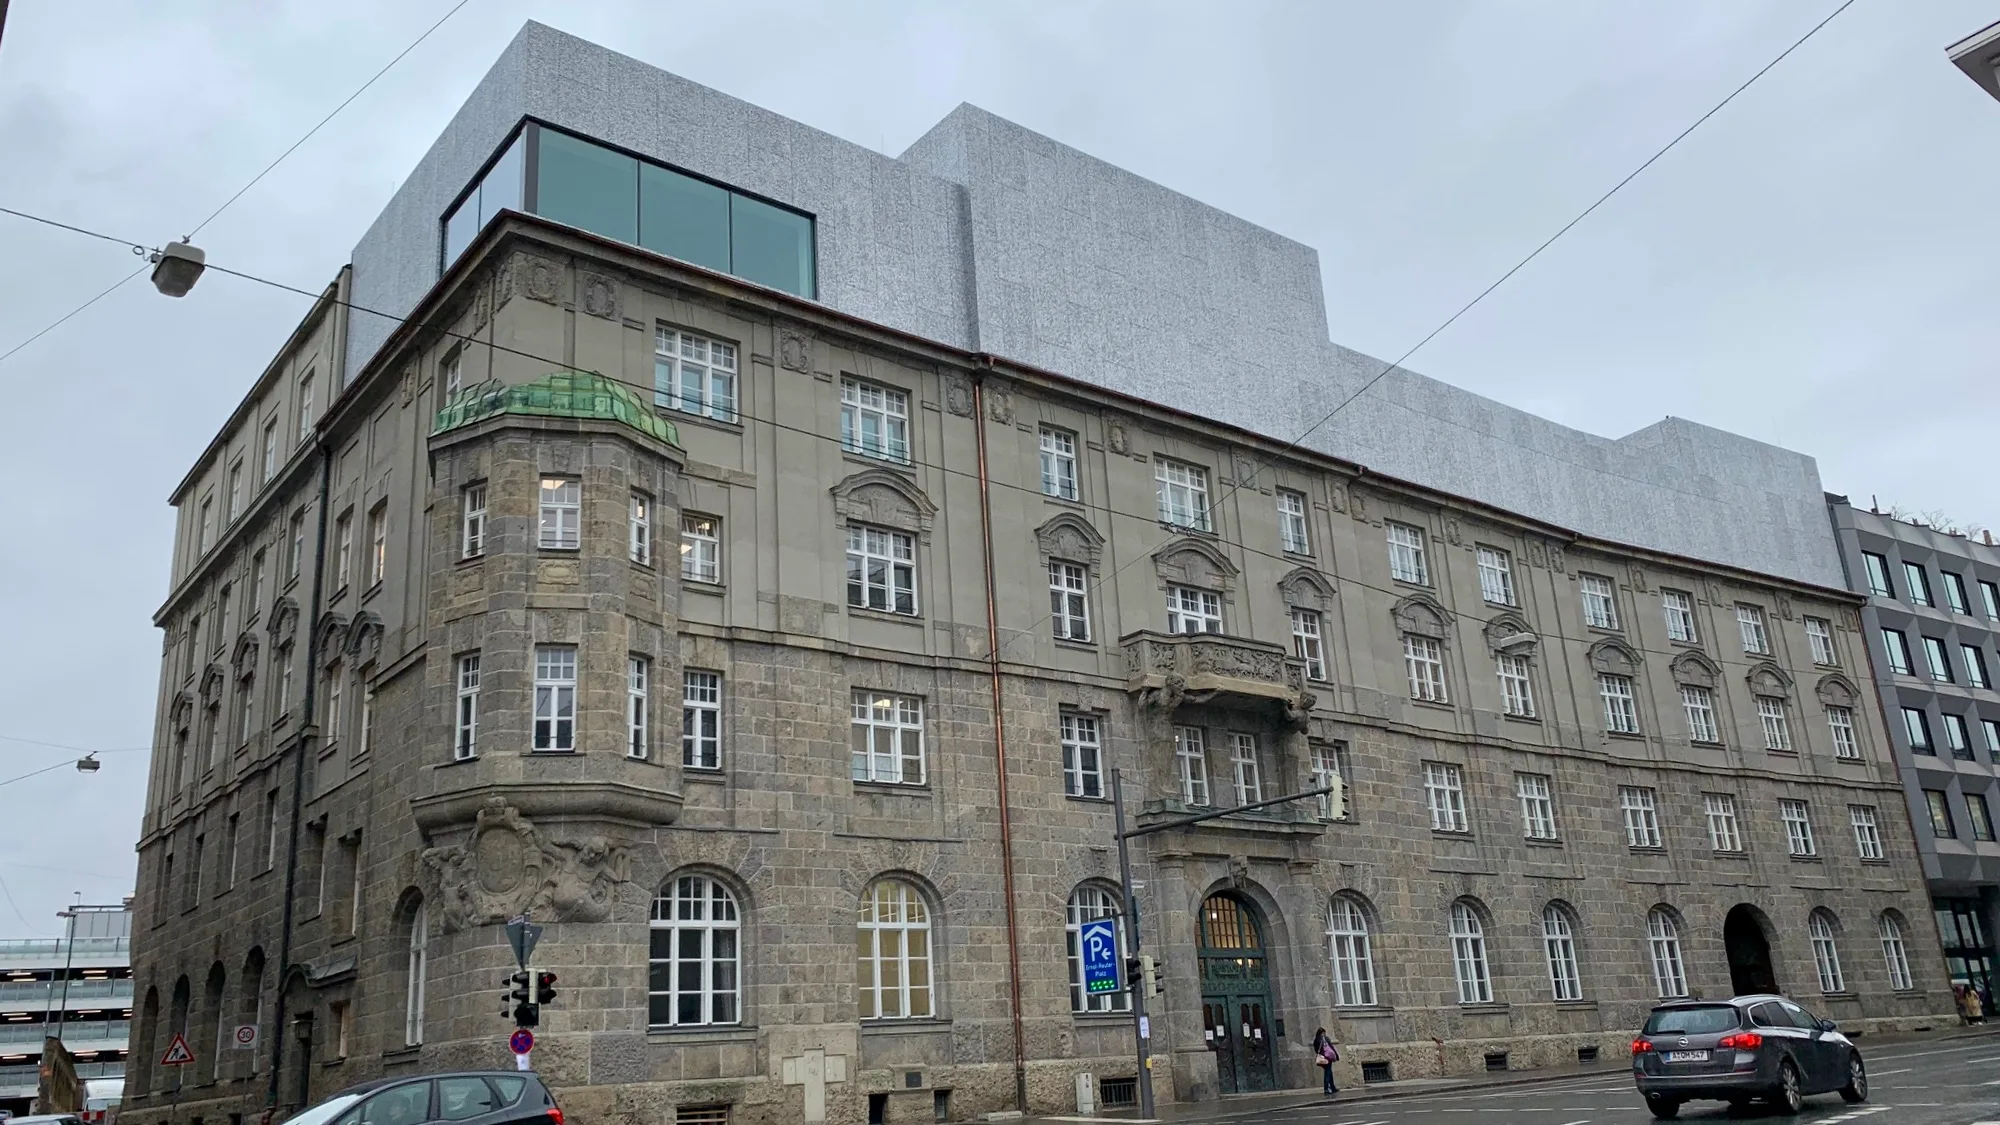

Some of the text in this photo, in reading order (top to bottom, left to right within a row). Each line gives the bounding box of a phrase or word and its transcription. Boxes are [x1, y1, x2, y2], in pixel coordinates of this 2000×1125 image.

[1090, 936, 1103, 962] P
[240, 1030, 251, 1039] 30
[1691, 1050, 1704, 1059] 547
